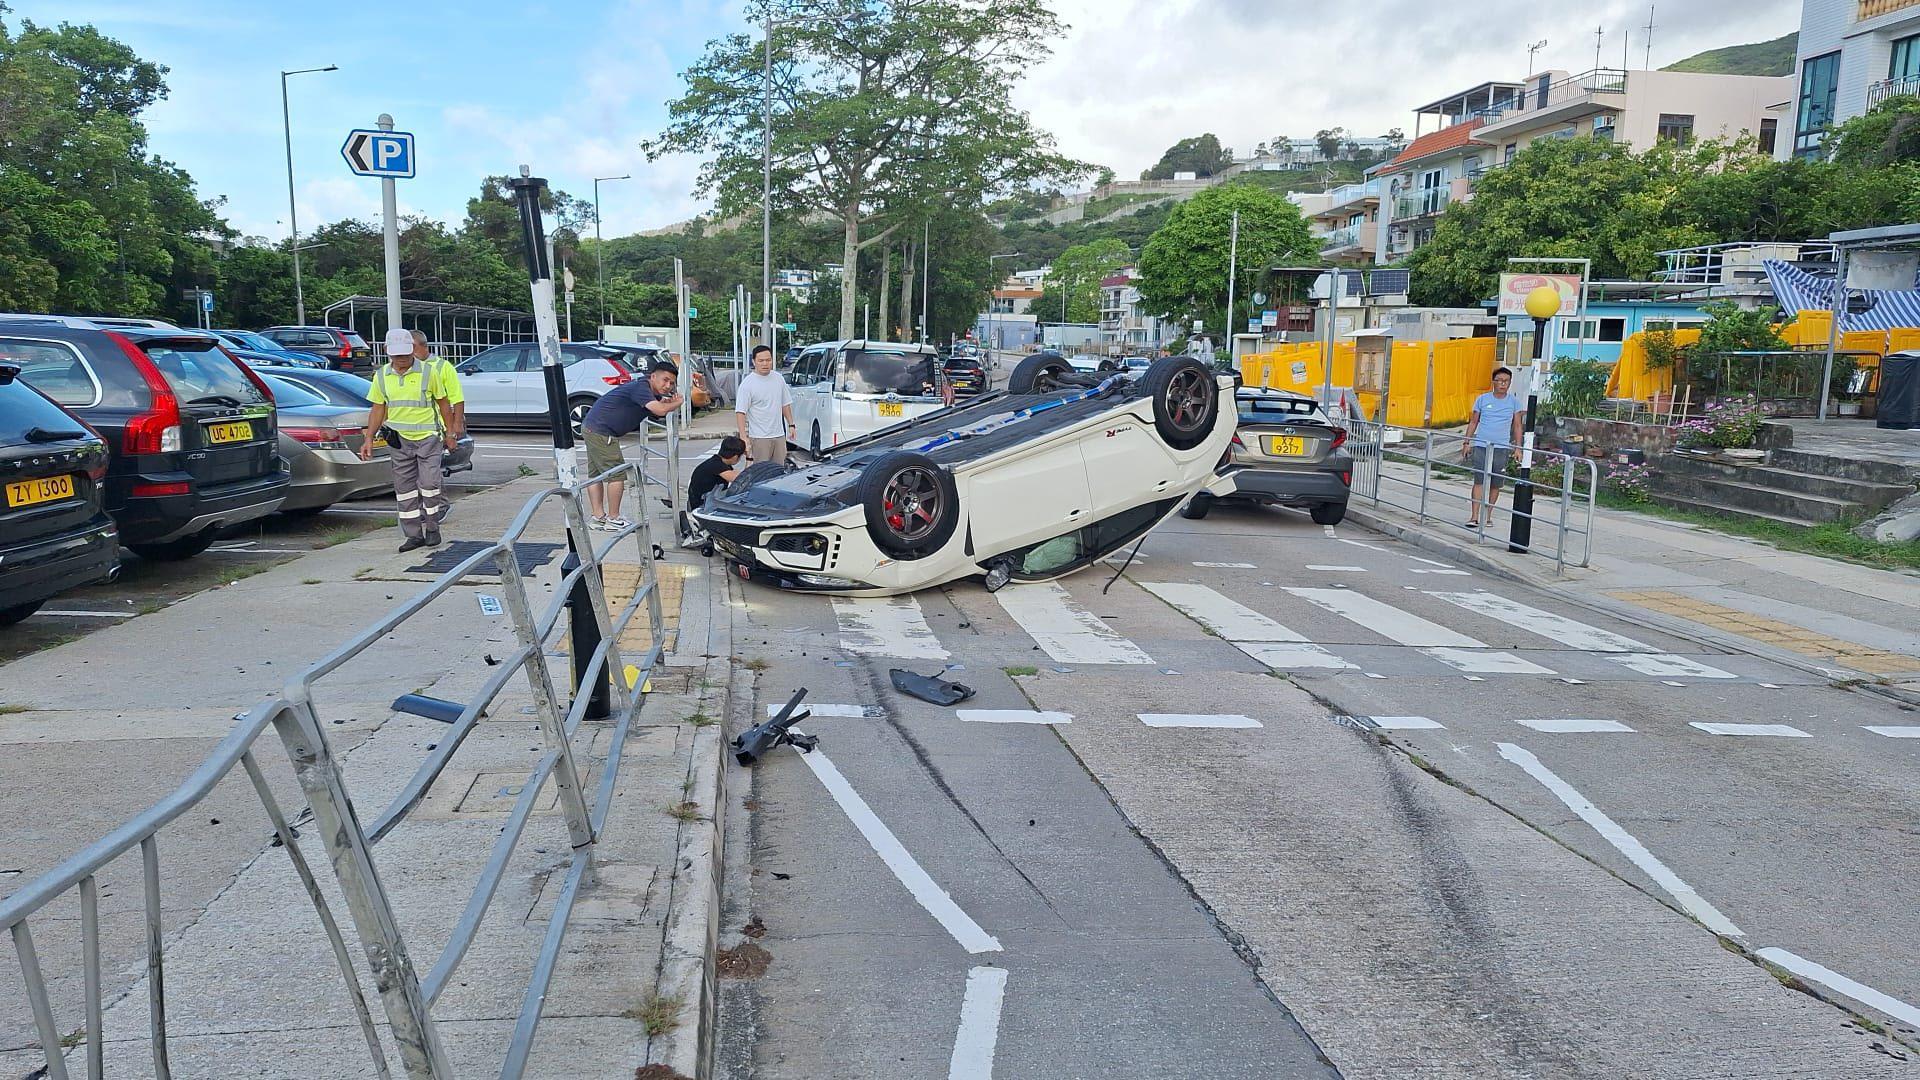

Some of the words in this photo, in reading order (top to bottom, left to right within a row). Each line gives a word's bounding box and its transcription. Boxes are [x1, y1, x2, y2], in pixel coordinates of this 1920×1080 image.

[377, 139, 402, 169] P
[204, 295, 211, 309] P
[212, 427, 226, 440] UC
[229, 425, 251, 439] 4702
[1105, 429, 1117, 438] R
[1281, 437, 1294, 446] XZ
[1276, 445, 1299, 455] 9217
[13, 484, 31, 503] ZY
[39, 478, 68, 499] 1300
